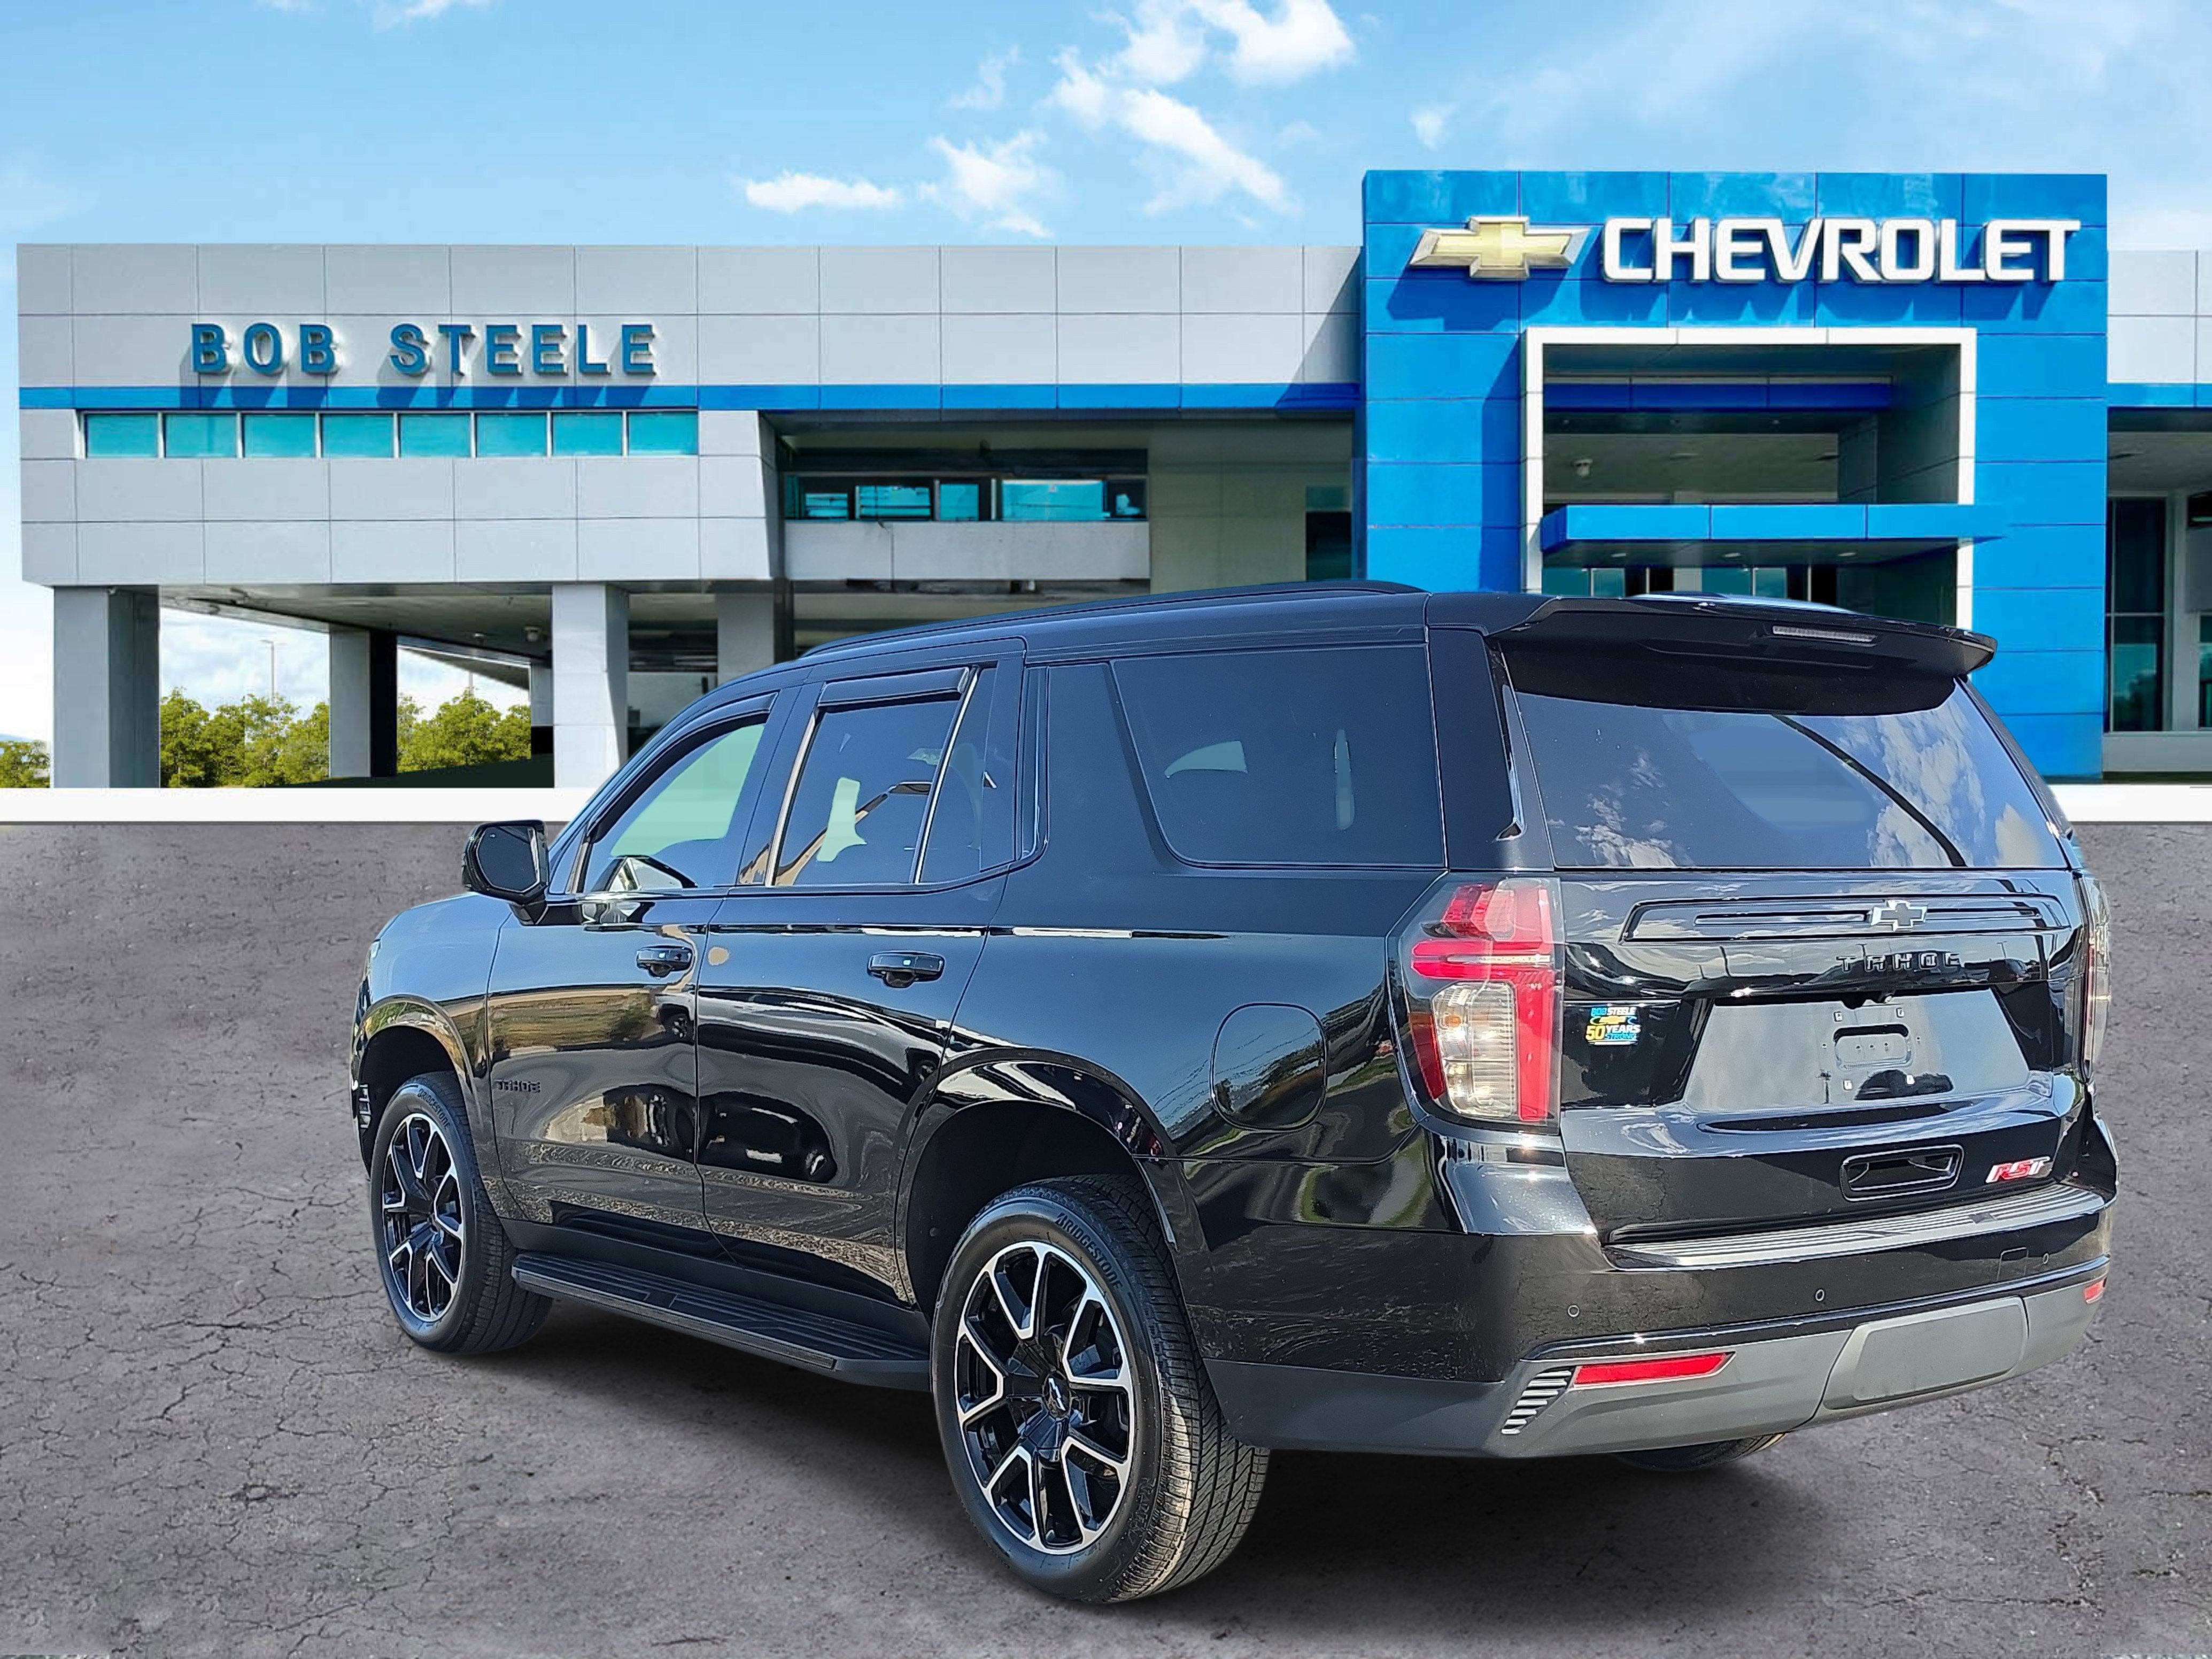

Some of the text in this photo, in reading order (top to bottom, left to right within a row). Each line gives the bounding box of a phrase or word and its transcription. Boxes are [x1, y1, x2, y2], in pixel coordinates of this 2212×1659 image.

[1602, 217, 2081, 284] CHEVROLET
[191, 322, 656, 376] BOB STEELE
[1836, 952, 1965, 972] TAHOE
[1591, 1007, 1637, 1016] BOB STEELE
[1585, 1024, 1641, 1041] 50 YEARS
[1985, 1156, 2051, 1184] RST
[1055, 1212, 1123, 1290] BRIDGESTONE
